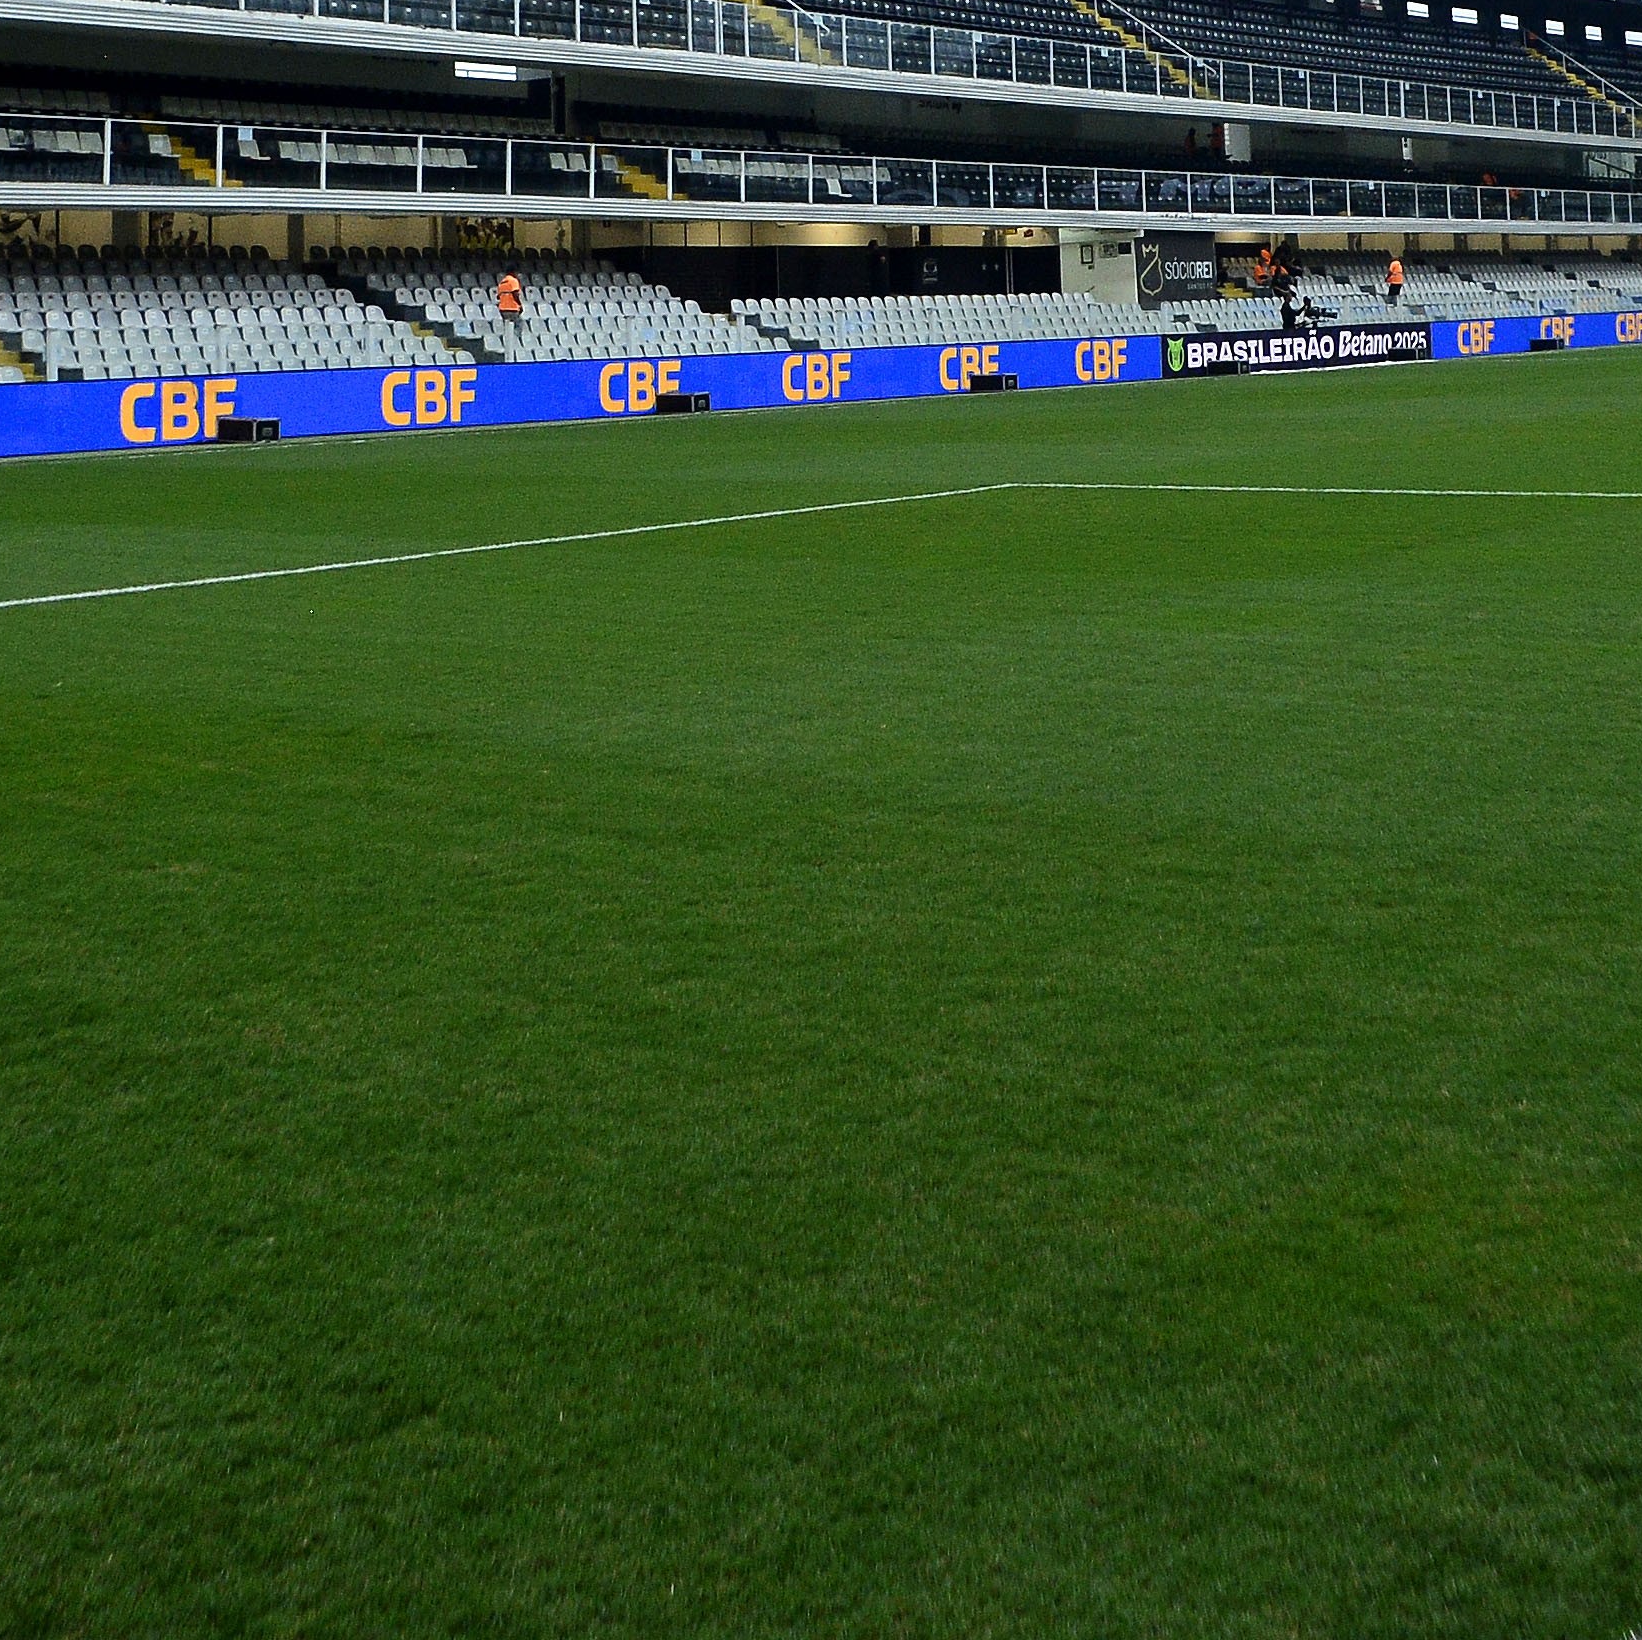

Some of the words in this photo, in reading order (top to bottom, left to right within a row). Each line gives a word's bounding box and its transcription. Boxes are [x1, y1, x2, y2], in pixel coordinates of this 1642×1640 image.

[1164, 257, 1214, 280] SÓCIOREI
[1186, 329, 1335, 369] BRASILEIRÃO
[1338, 330, 1393, 358] Betano
[1393, 331, 1427, 350] 2025
[1457, 320, 1495, 354] CBF
[1540, 316, 1575, 346] CBF
[782, 352, 852, 401] CBF
[939, 345, 1001, 391] CBF
[1074, 339, 1127, 382] CBF
[381, 368, 478, 426] CBF
[599, 360, 682, 413] CBF
[120, 378, 238, 443] CBF
